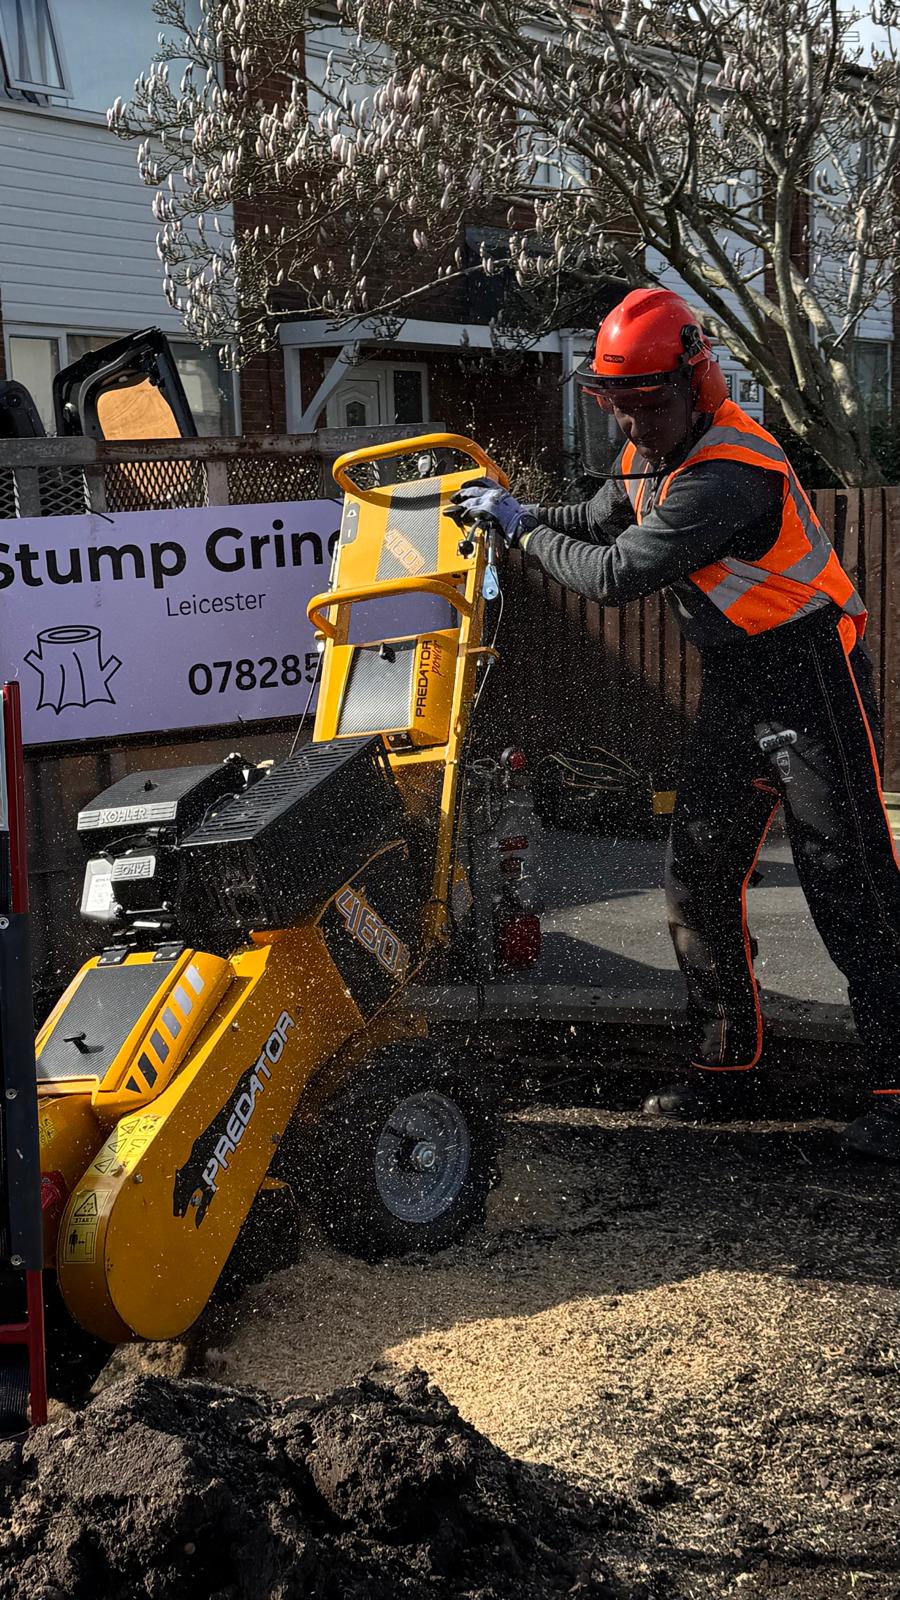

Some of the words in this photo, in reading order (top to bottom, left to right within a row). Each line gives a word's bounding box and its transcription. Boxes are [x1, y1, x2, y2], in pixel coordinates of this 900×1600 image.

[166, 592, 267, 617] Leicester
[431, 640, 445, 677] power
[415, 640, 432, 718] PREDATOR
[100, 807, 148, 824] KOHLER
[121, 863, 144, 875] OHV
[336, 889, 400, 971] 460
[202, 1009, 295, 1193] PREDATOR
